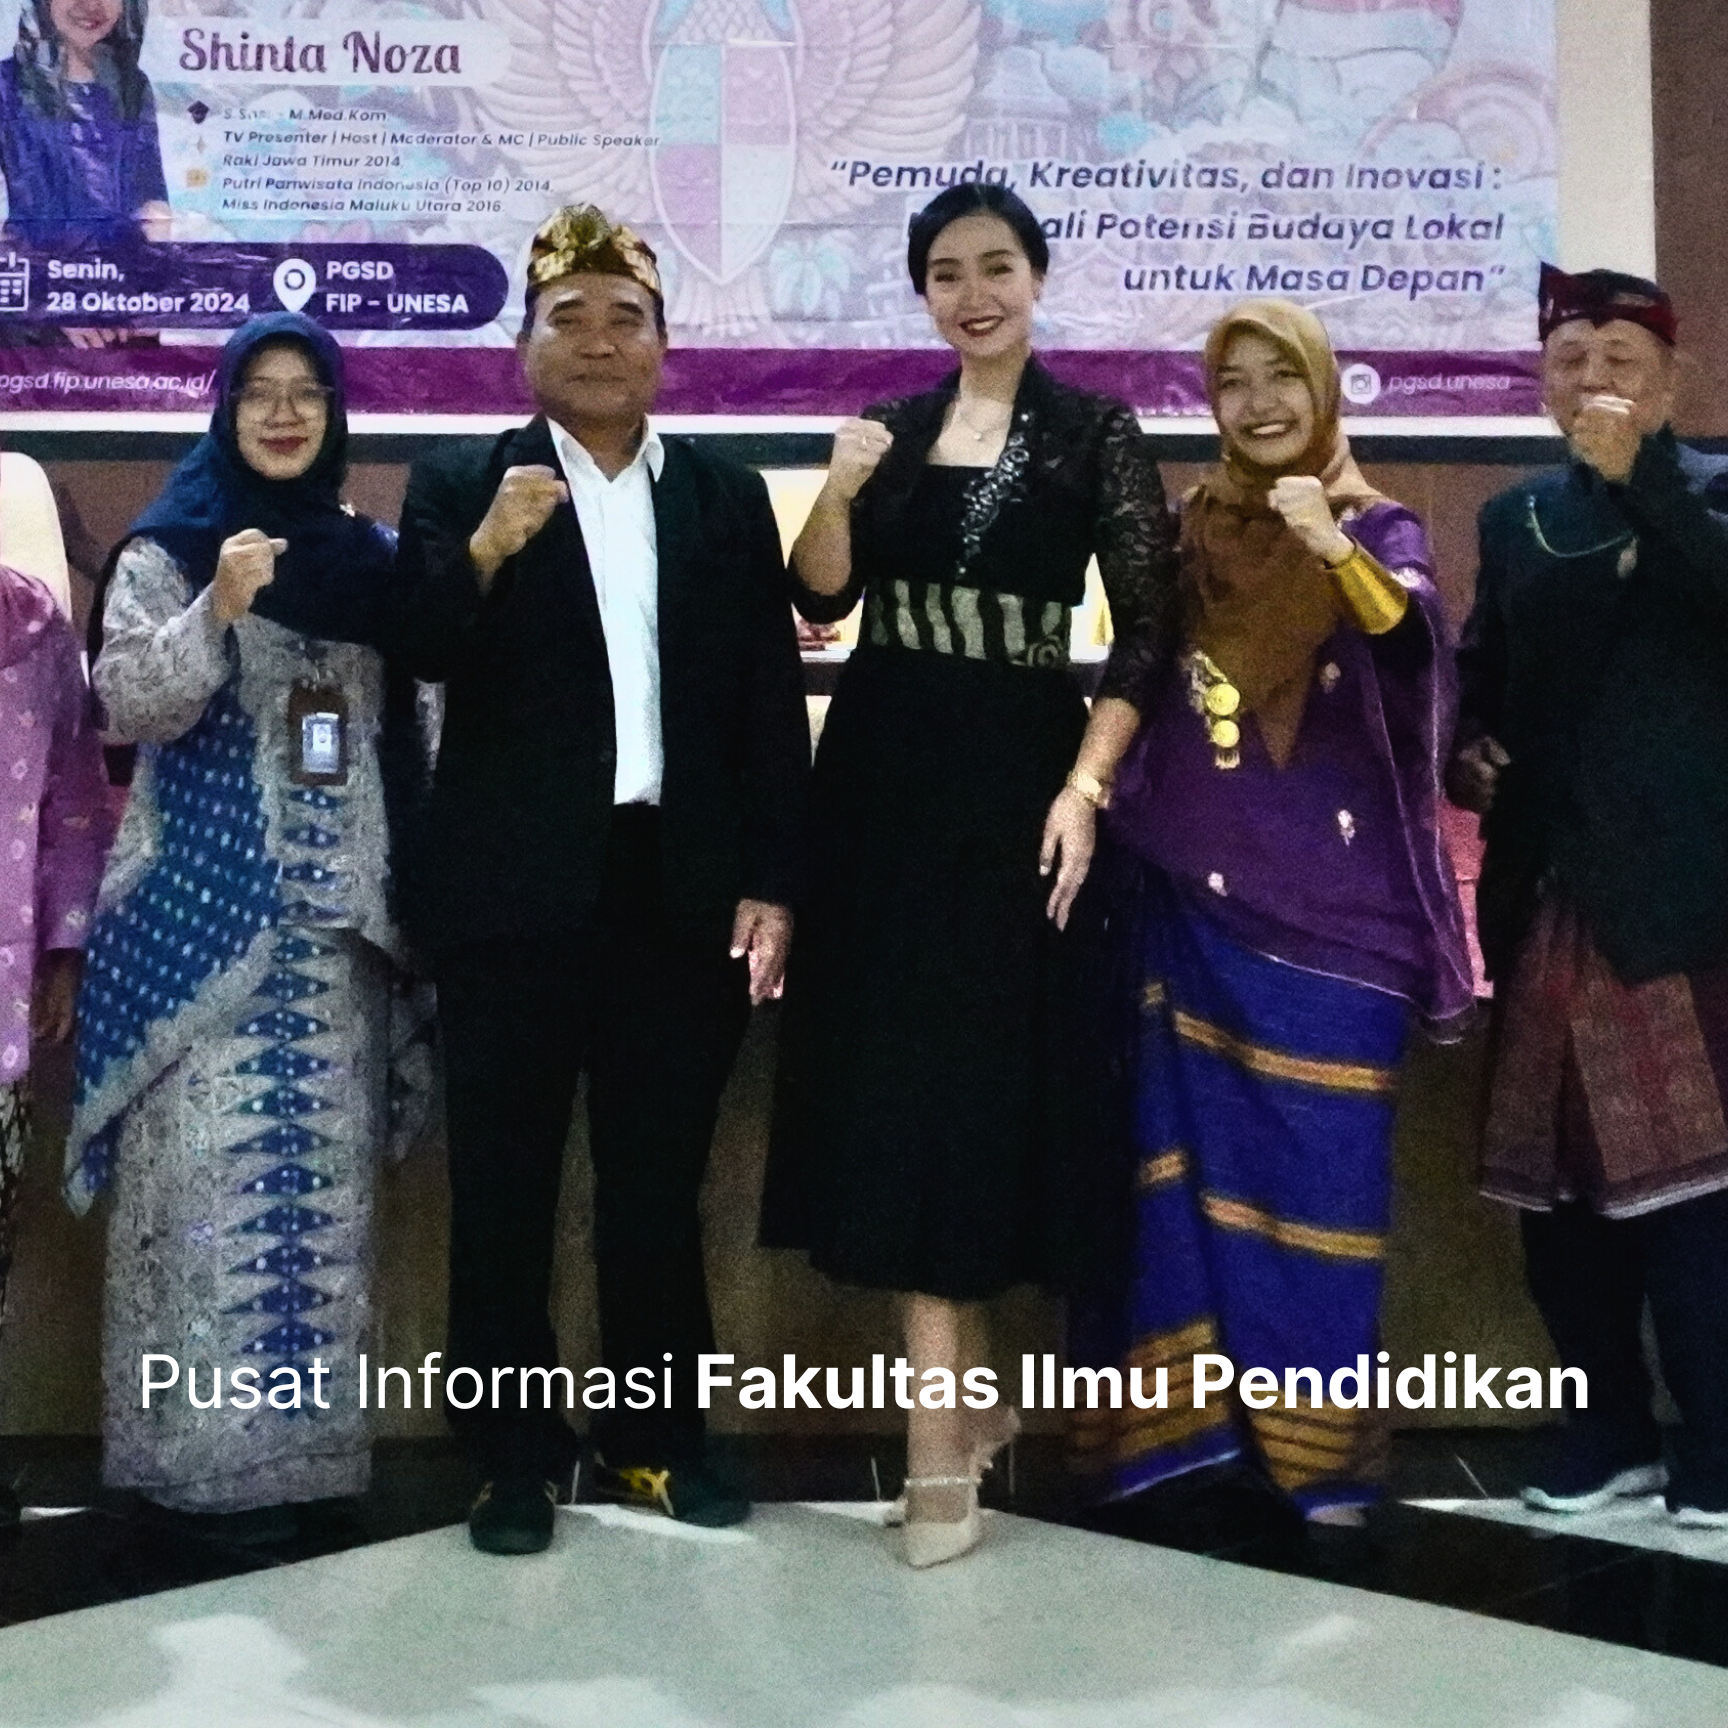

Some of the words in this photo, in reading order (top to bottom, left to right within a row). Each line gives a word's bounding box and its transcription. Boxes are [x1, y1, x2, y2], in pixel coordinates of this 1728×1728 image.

[179, 28, 327, 72] Shinta
[343, 31, 462, 73] Noza
[224, 131, 244, 143] TV
[248, 131, 328, 144] Presenter
[341, 132, 378, 145] Host
[391, 132, 476, 145] Moderator
[481, 134, 492, 145] &
[499, 135, 524, 146] MC
[537, 134, 587, 146] Public
[593, 134, 660, 149] Speaker
[262, 156, 306, 167] Jawa
[312, 156, 360, 167] Timur
[223, 177, 261, 191] Putri
[265, 177, 353, 191] Pariwisata
[357, 178, 439, 191] Indonesia
[444, 177, 483, 195] (Top
[487, 177, 510, 193] 10)
[1029, 161, 1250, 193] Kreativitas,
[1261, 162, 1334, 190] dan
[1345, 162, 1484, 190] Inovasi
[222, 199, 258, 212] Miss
[263, 199, 345, 212] Indonesia
[350, 199, 410, 212] Maluku
[416, 200, 462, 212] Utara
[1096, 212, 1236, 242] Potensi
[1248, 216, 1393, 249] Budaya
[1405, 214, 1503, 242] Lokal
[47, 259, 126, 282] Senin,
[326, 261, 394, 281] PGSD
[1124, 265, 1231, 292] untuk
[1245, 266, 1348, 292] Masa
[46, 292, 76, 313] 28
[82, 292, 185, 314] Oktober
[190, 292, 251, 314] 2024
[326, 294, 362, 313] FIP
[387, 294, 469, 314] UNESA
